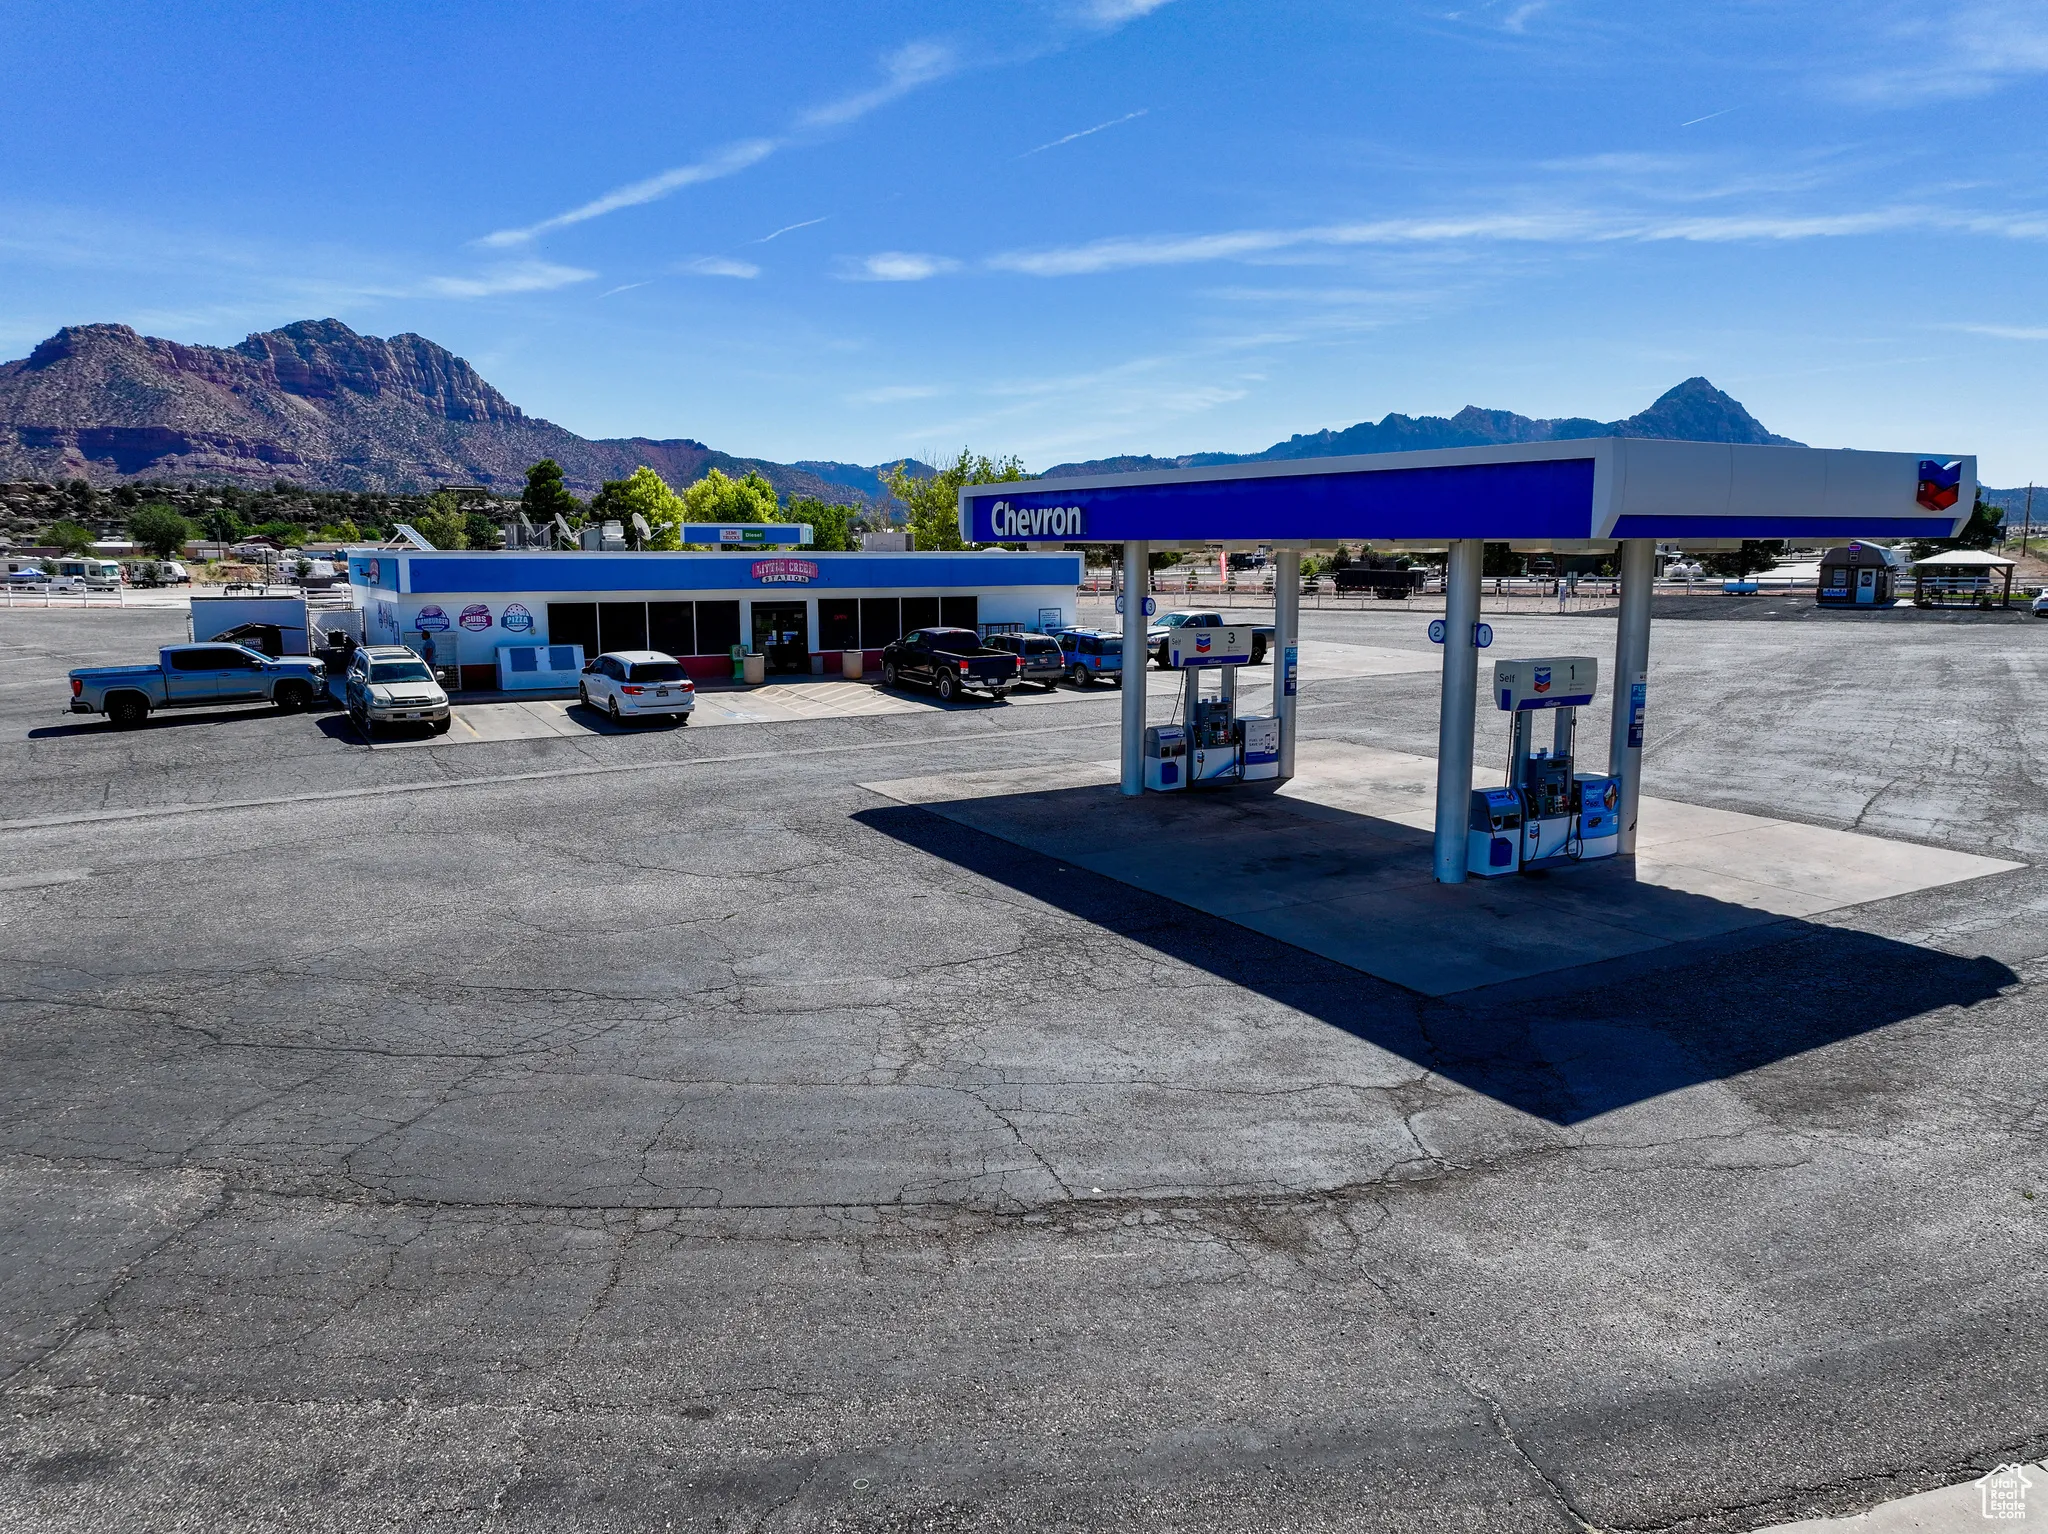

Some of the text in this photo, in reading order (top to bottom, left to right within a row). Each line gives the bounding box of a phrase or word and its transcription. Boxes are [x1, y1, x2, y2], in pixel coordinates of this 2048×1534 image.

[991, 501, 1081, 537] Chevron
[756, 562, 785, 575] LITTLE
[765, 575, 807, 583] STATION
[1148, 602, 1153, 611] 3
[417, 617, 449, 625] HAMBURGER
[1433, 626, 1441, 637] 2
[1482, 630, 1487, 641] 1
[1228, 632, 1236, 644] 3
[1570, 664, 1575, 680] 1
[1499, 673, 1516, 683] Self
